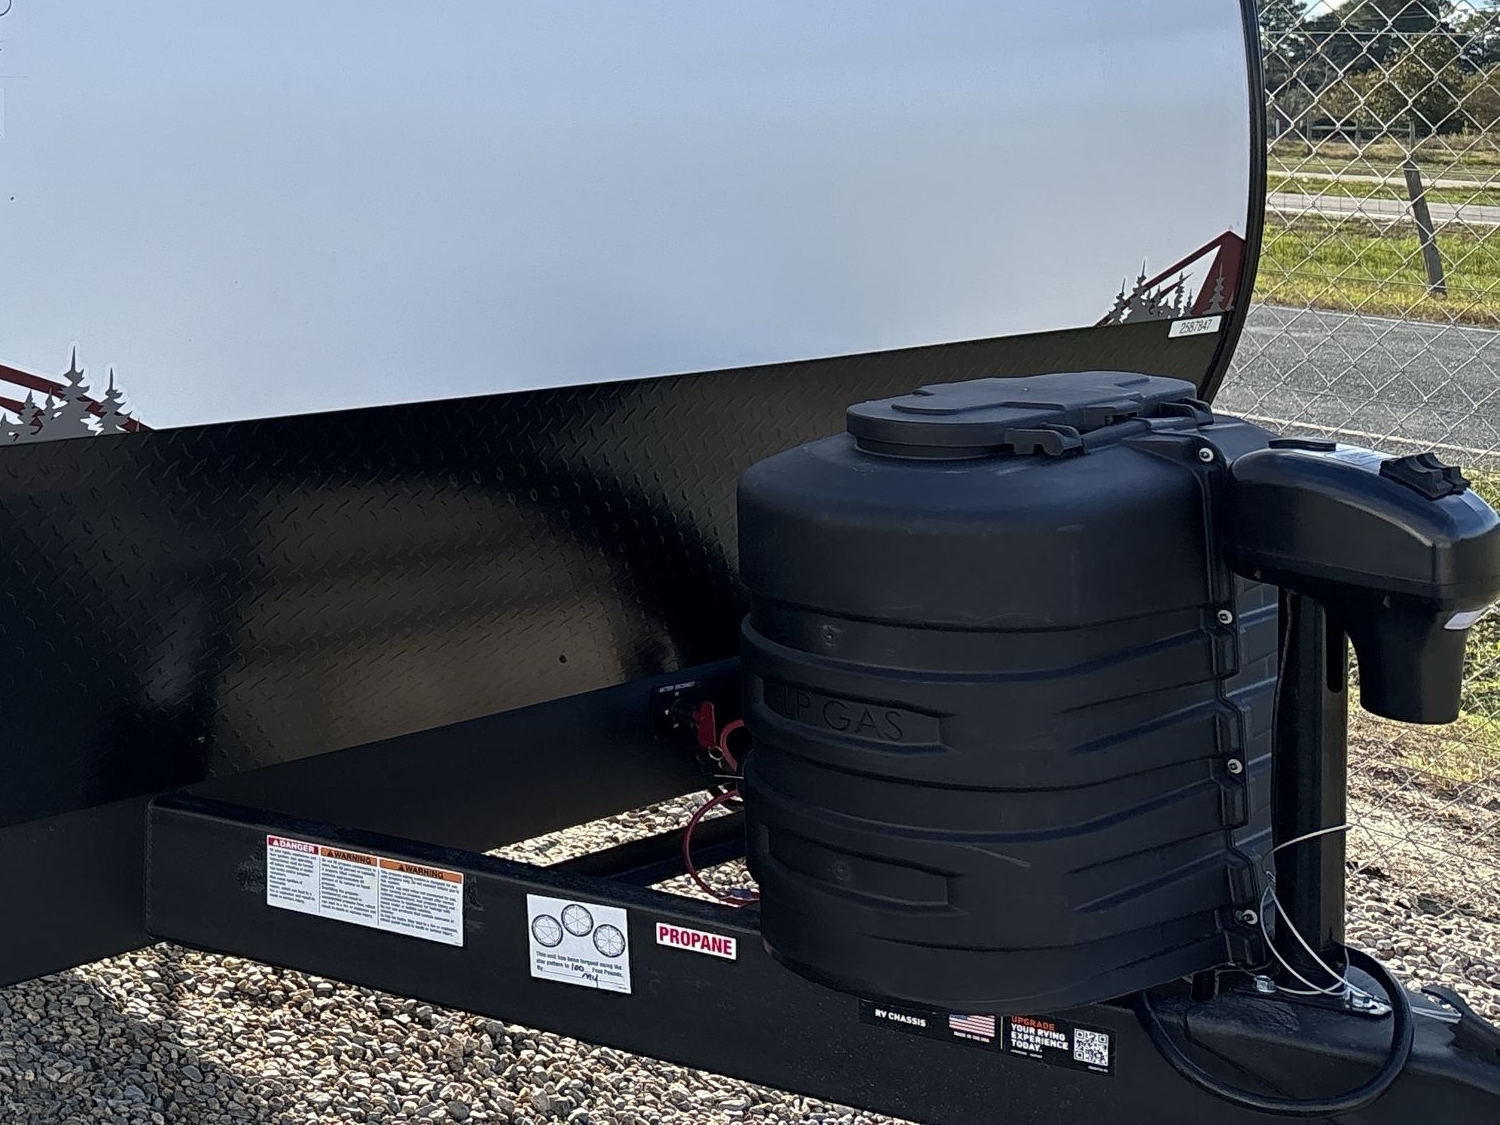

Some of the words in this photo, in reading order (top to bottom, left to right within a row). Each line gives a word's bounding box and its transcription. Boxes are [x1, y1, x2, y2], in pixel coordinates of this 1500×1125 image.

[783, 686, 811, 718] LP
[822, 699, 904, 742] GAS
[279, 839, 316, 854] DANGER
[334, 850, 372, 866] WARNING
[406, 864, 444, 880] WARNING
[659, 926, 733, 956] PROPANE
[875, 1008, 887, 1018] RV
[888, 1012, 926, 1027] CHASSIS
[1011, 1015, 1055, 1031] UPGRADE
[1011, 1023, 1035, 1035] YOUR
[1037, 1028, 1066, 1041] RVING
[1011, 1031, 1069, 1051] EXPERIENCE
[1011, 1038, 1043, 1053] TODAY.
